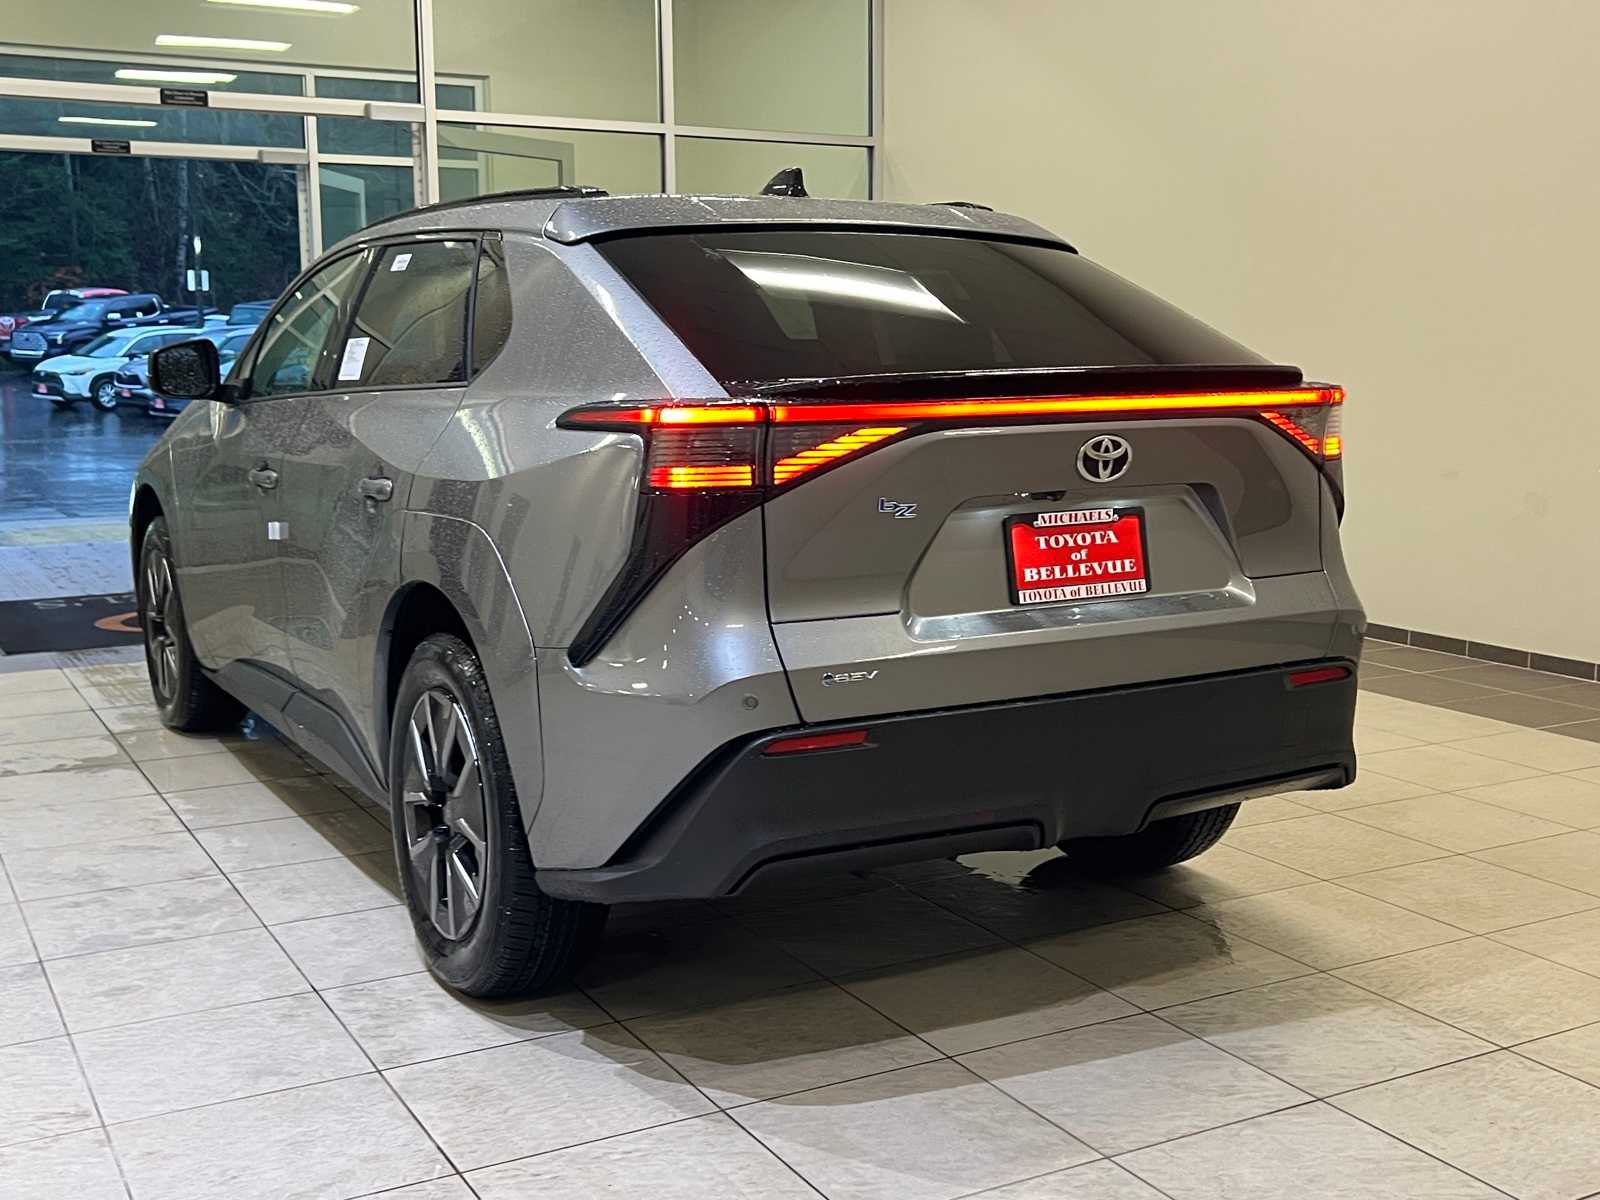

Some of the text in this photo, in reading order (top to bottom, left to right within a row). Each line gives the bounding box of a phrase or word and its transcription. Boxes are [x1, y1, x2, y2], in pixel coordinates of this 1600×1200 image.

[1039, 510, 1112, 525] MICHAELS
[1035, 531, 1118, 549] TOYOTA
[1071, 549, 1088, 561] of
[1024, 559, 1136, 582] BELLEVUE
[1021, 580, 1146, 602] TOYOTA of BELLEVUE
